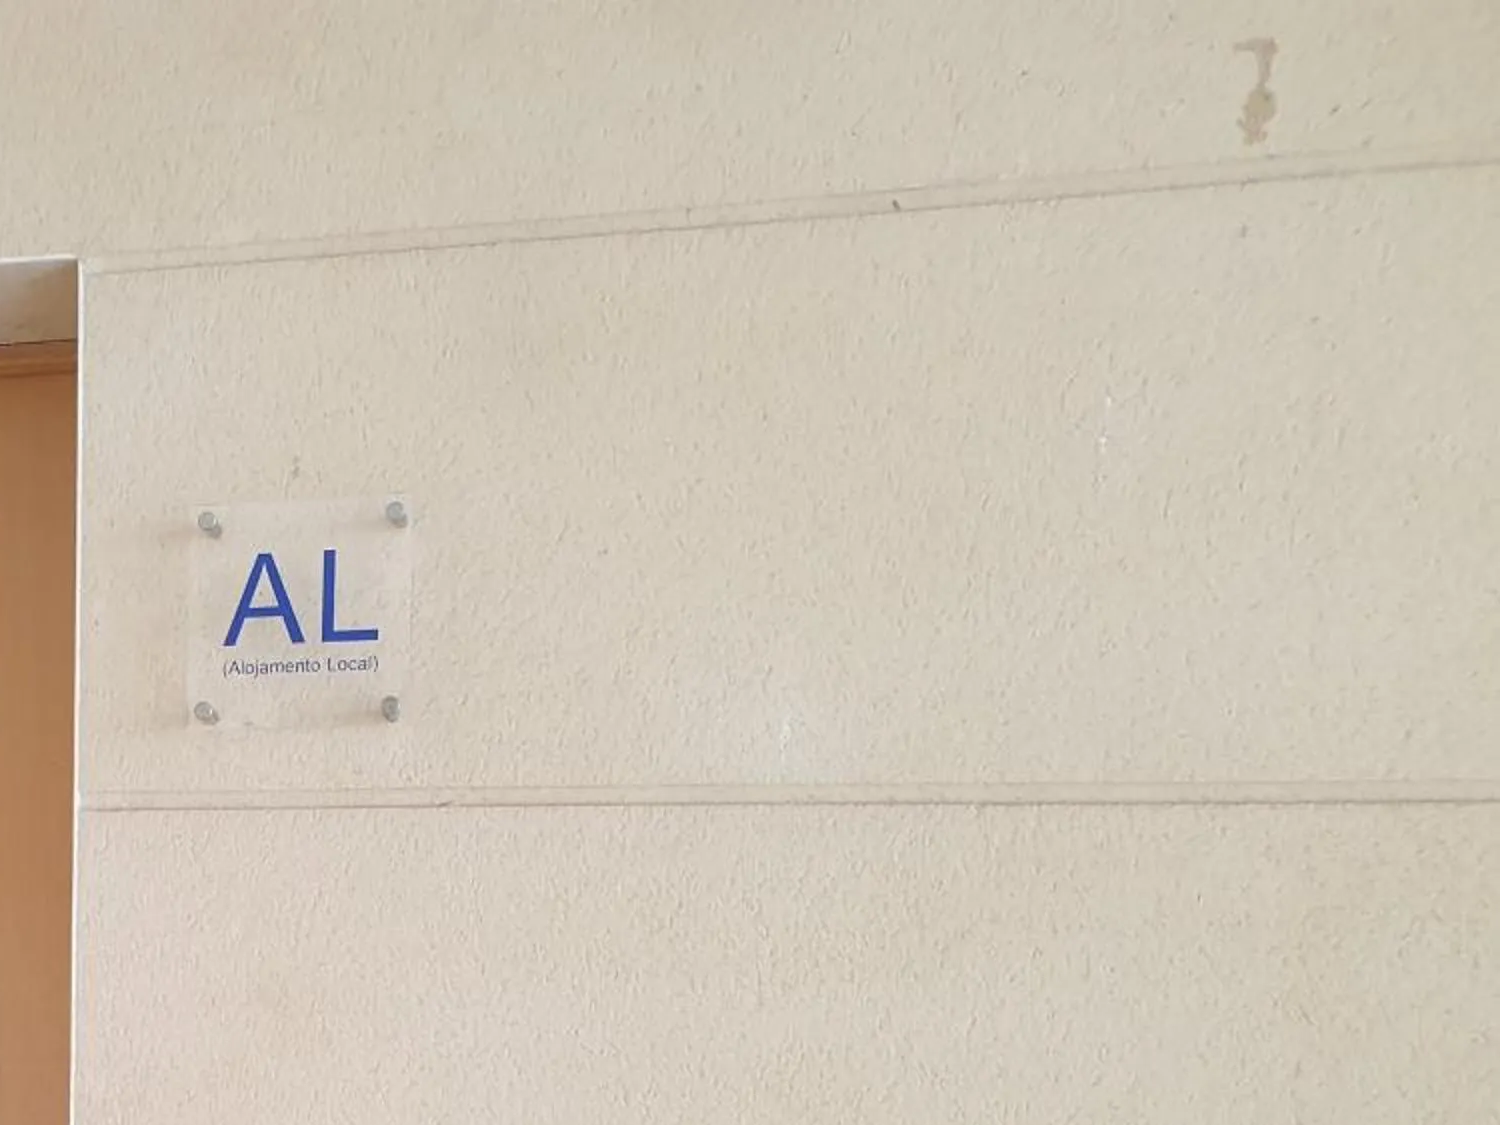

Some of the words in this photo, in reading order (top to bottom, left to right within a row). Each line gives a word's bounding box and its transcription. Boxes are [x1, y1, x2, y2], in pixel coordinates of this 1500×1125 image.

[223, 549, 379, 647] AL
[222, 658, 321, 679] (Alojamento
[327, 655, 379, 673] Local)
